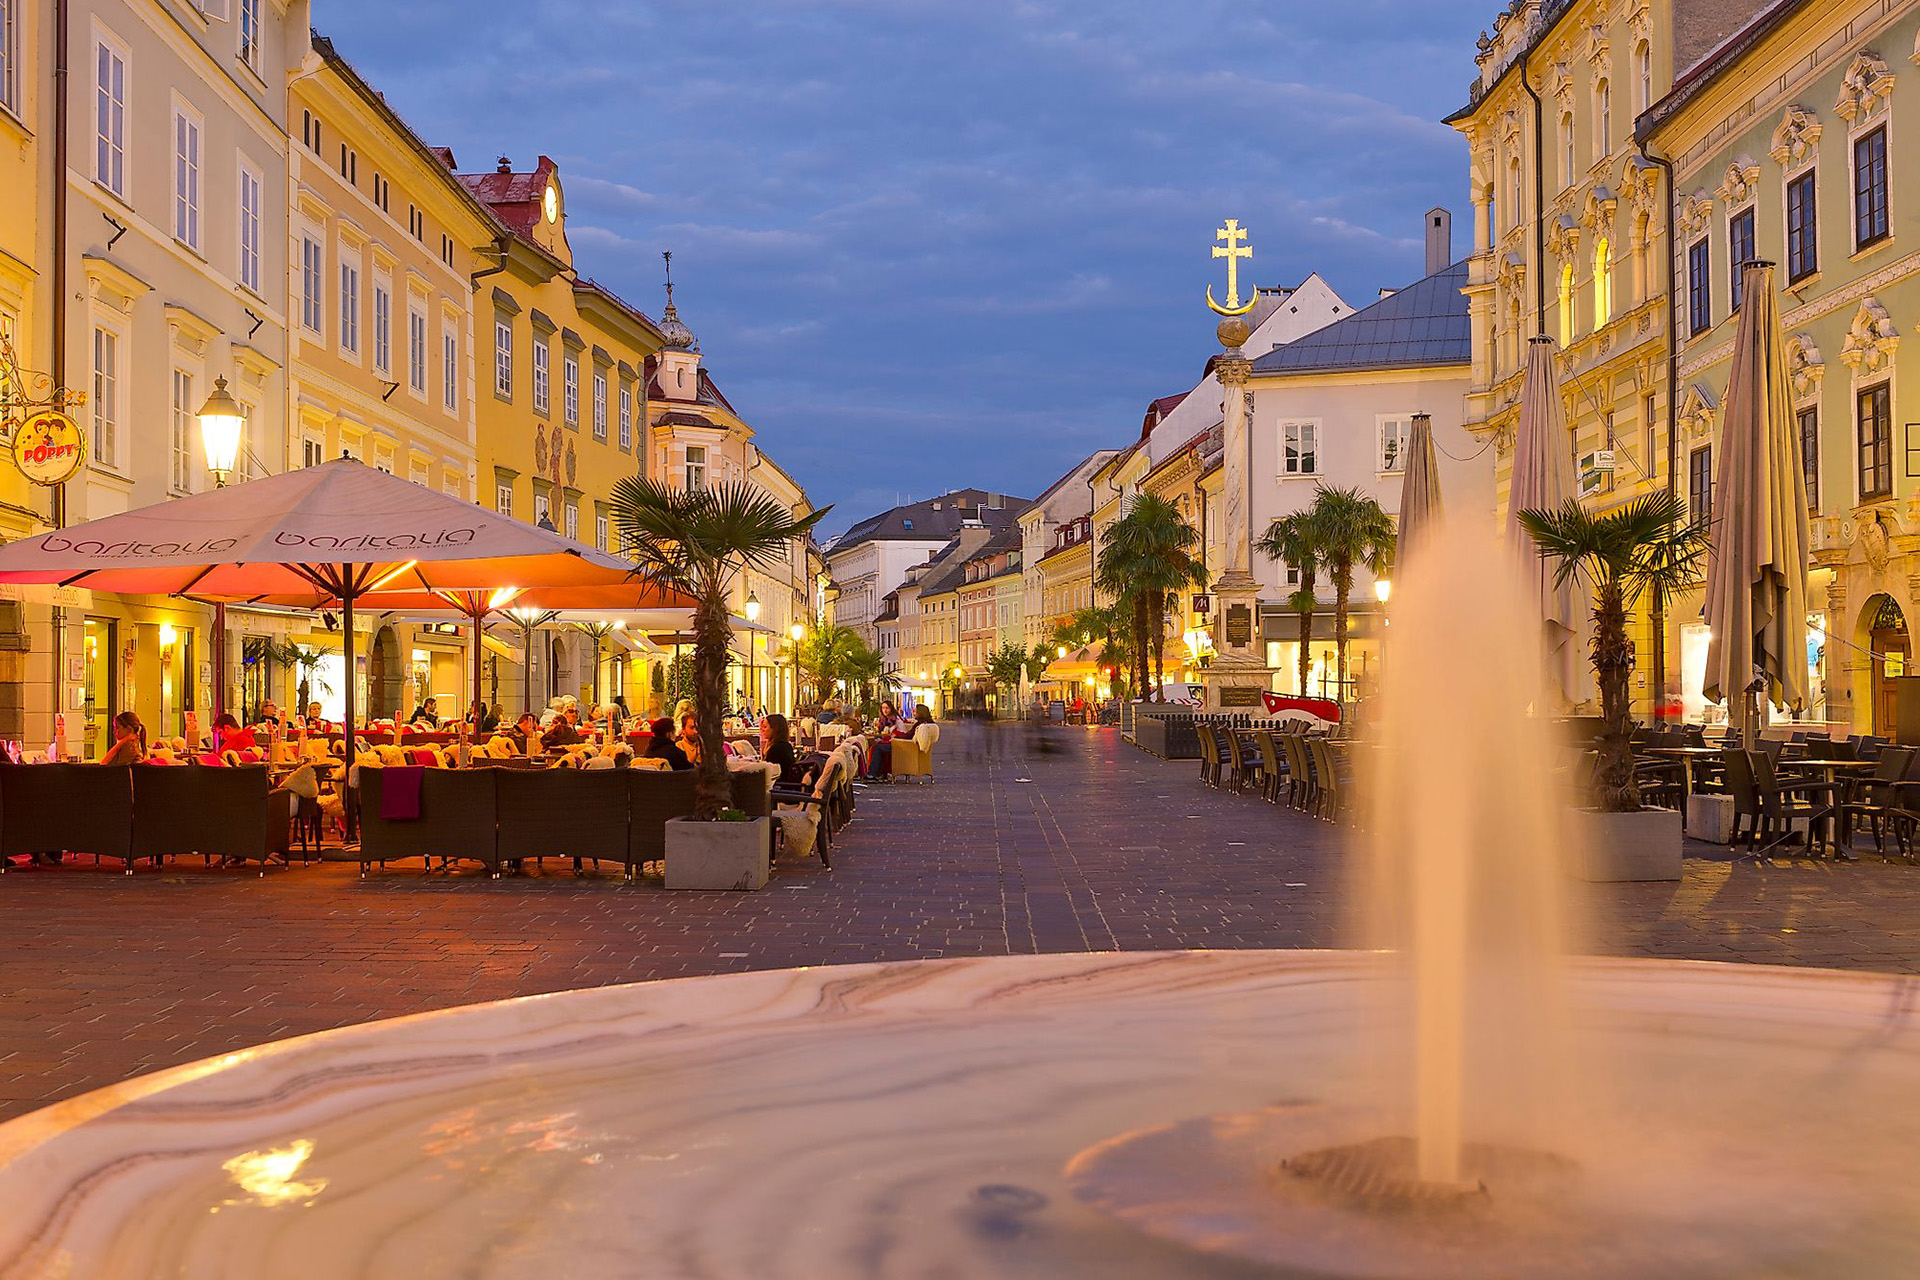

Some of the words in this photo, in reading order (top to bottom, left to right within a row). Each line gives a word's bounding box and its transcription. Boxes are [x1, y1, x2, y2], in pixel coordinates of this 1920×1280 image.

[24, 444, 76, 465] POPPY
[41, 535, 237, 555] baritalia
[275, 528, 475, 548] baritalia
